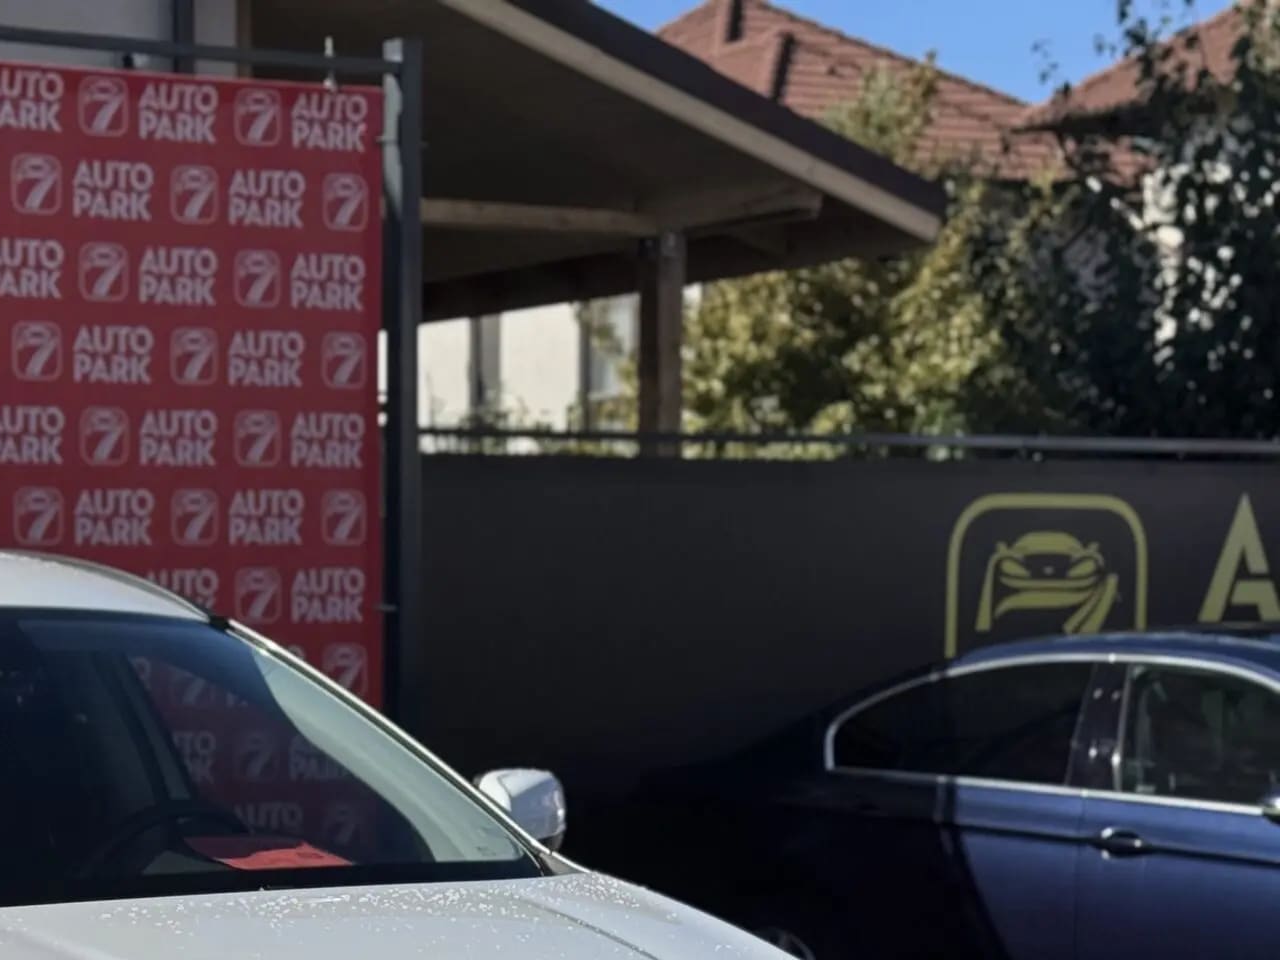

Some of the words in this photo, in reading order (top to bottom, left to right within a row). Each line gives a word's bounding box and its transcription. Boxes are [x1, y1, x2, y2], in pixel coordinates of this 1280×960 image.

[139, 84, 218, 117] AUTO
[291, 93, 367, 123] AUTO
[138, 110, 216, 144] PARK
[291, 120, 365, 153] PARK
[73, 161, 154, 193] AUTO
[228, 170, 306, 200] AUTO
[73, 188, 152, 220] PARK
[228, 196, 304, 228] PARK
[140, 248, 217, 278] AUTO
[291, 254, 365, 282] AUTO
[139, 275, 216, 306] PARK
[291, 279, 363, 311] PARK
[73, 325, 153, 356] AUTO
[228, 330, 304, 359] AUTO
[73, 352, 151, 384] PARK
[228, 356, 302, 387] PARK
[140, 410, 217, 438] AUTO
[291, 412, 365, 440] AUTO
[140, 436, 216, 467] PARK
[291, 438, 363, 467] PARK
[75, 490, 154, 518] AUTO
[229, 490, 304, 517] AUTO
[75, 516, 152, 546] PARK
[229, 515, 303, 546] PARK
[291, 568, 365, 594] AUTO
[291, 594, 363, 622] PARK
